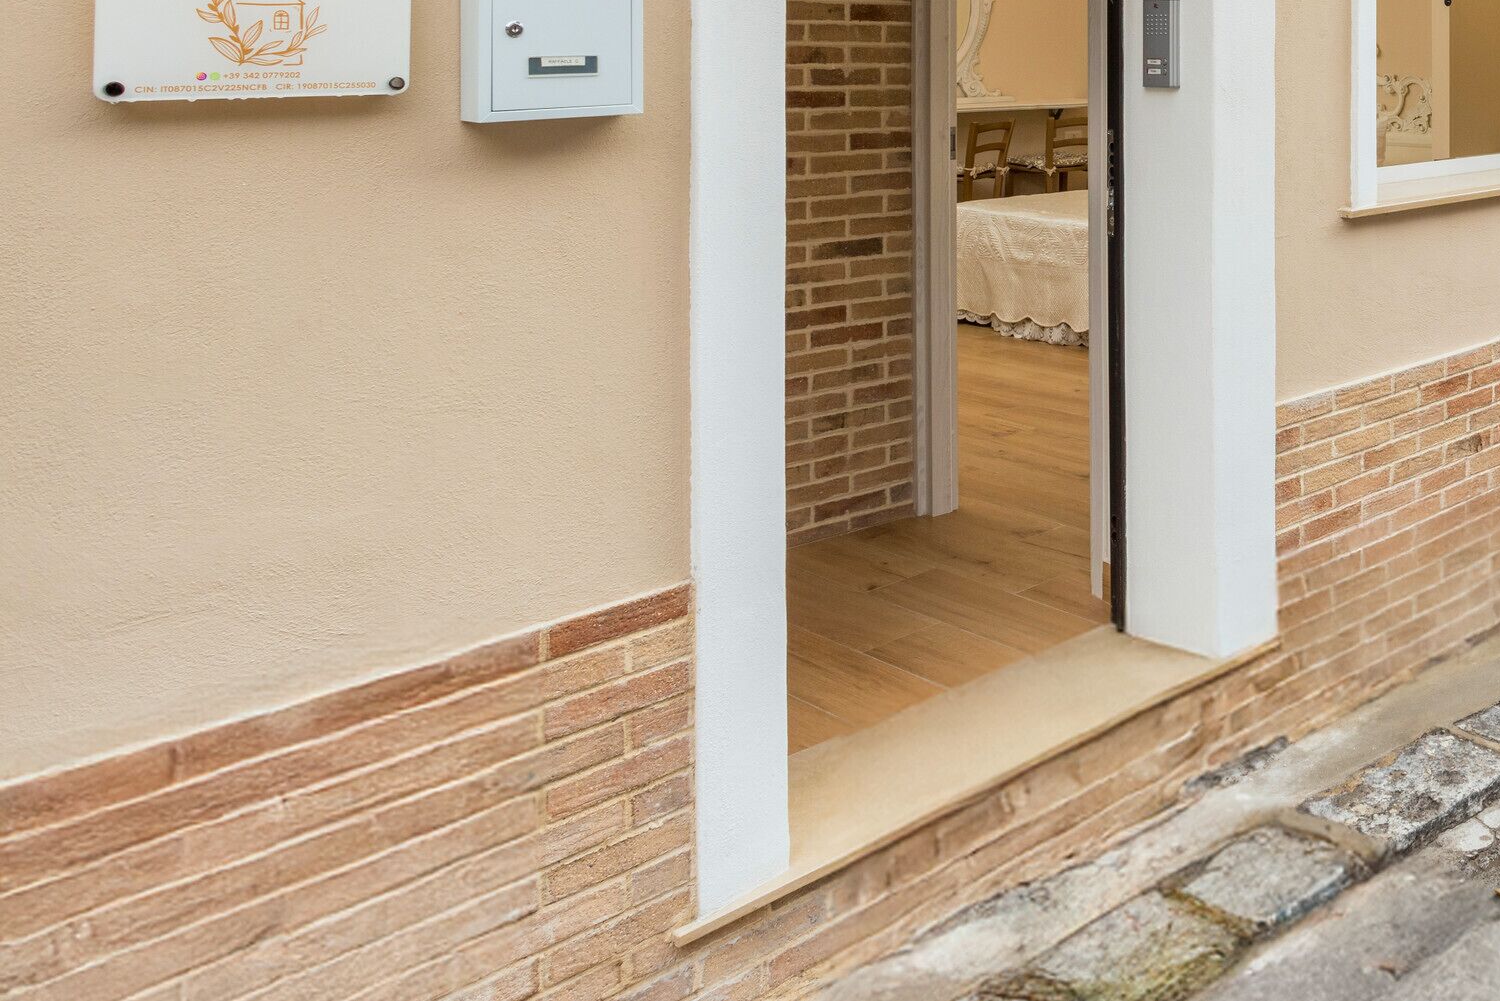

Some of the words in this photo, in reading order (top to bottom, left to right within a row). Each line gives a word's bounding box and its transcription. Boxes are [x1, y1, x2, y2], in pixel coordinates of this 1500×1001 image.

[223, 72, 240, 80] +39
[243, 72, 260, 80] 342
[134, 86, 157, 94] CIN:
